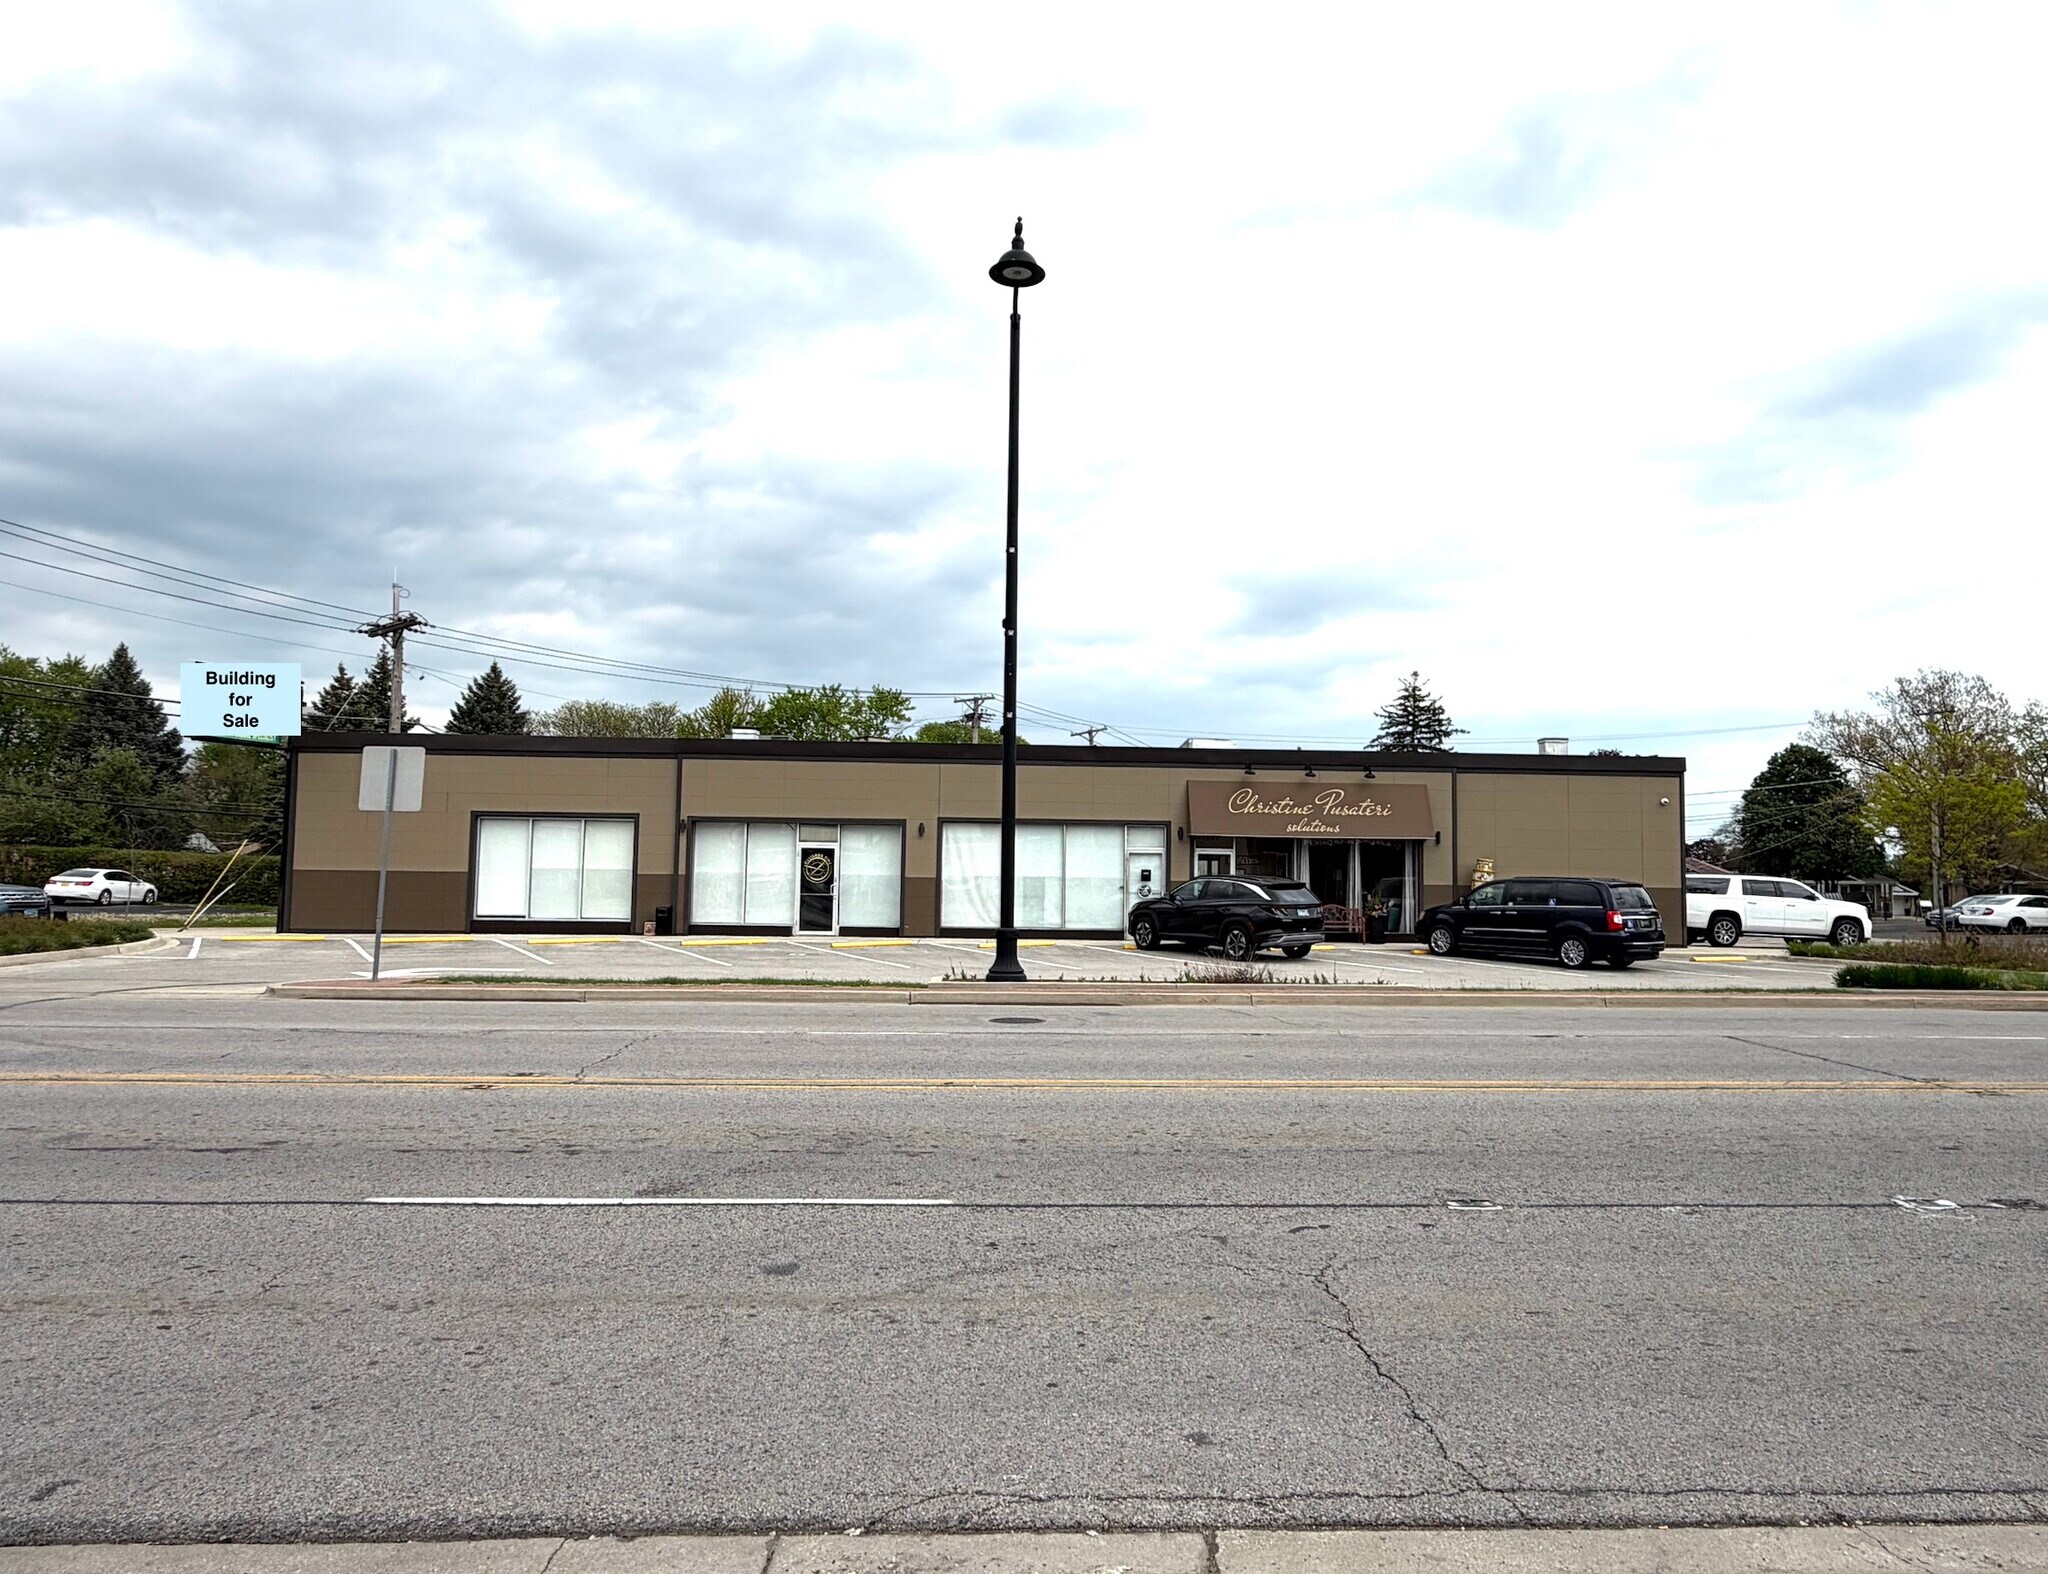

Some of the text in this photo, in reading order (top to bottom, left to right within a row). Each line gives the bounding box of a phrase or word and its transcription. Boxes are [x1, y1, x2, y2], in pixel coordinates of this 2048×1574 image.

[1228, 788, 1393, 816] Christine Pusateri
[1286, 818, 1341, 833] solutions
